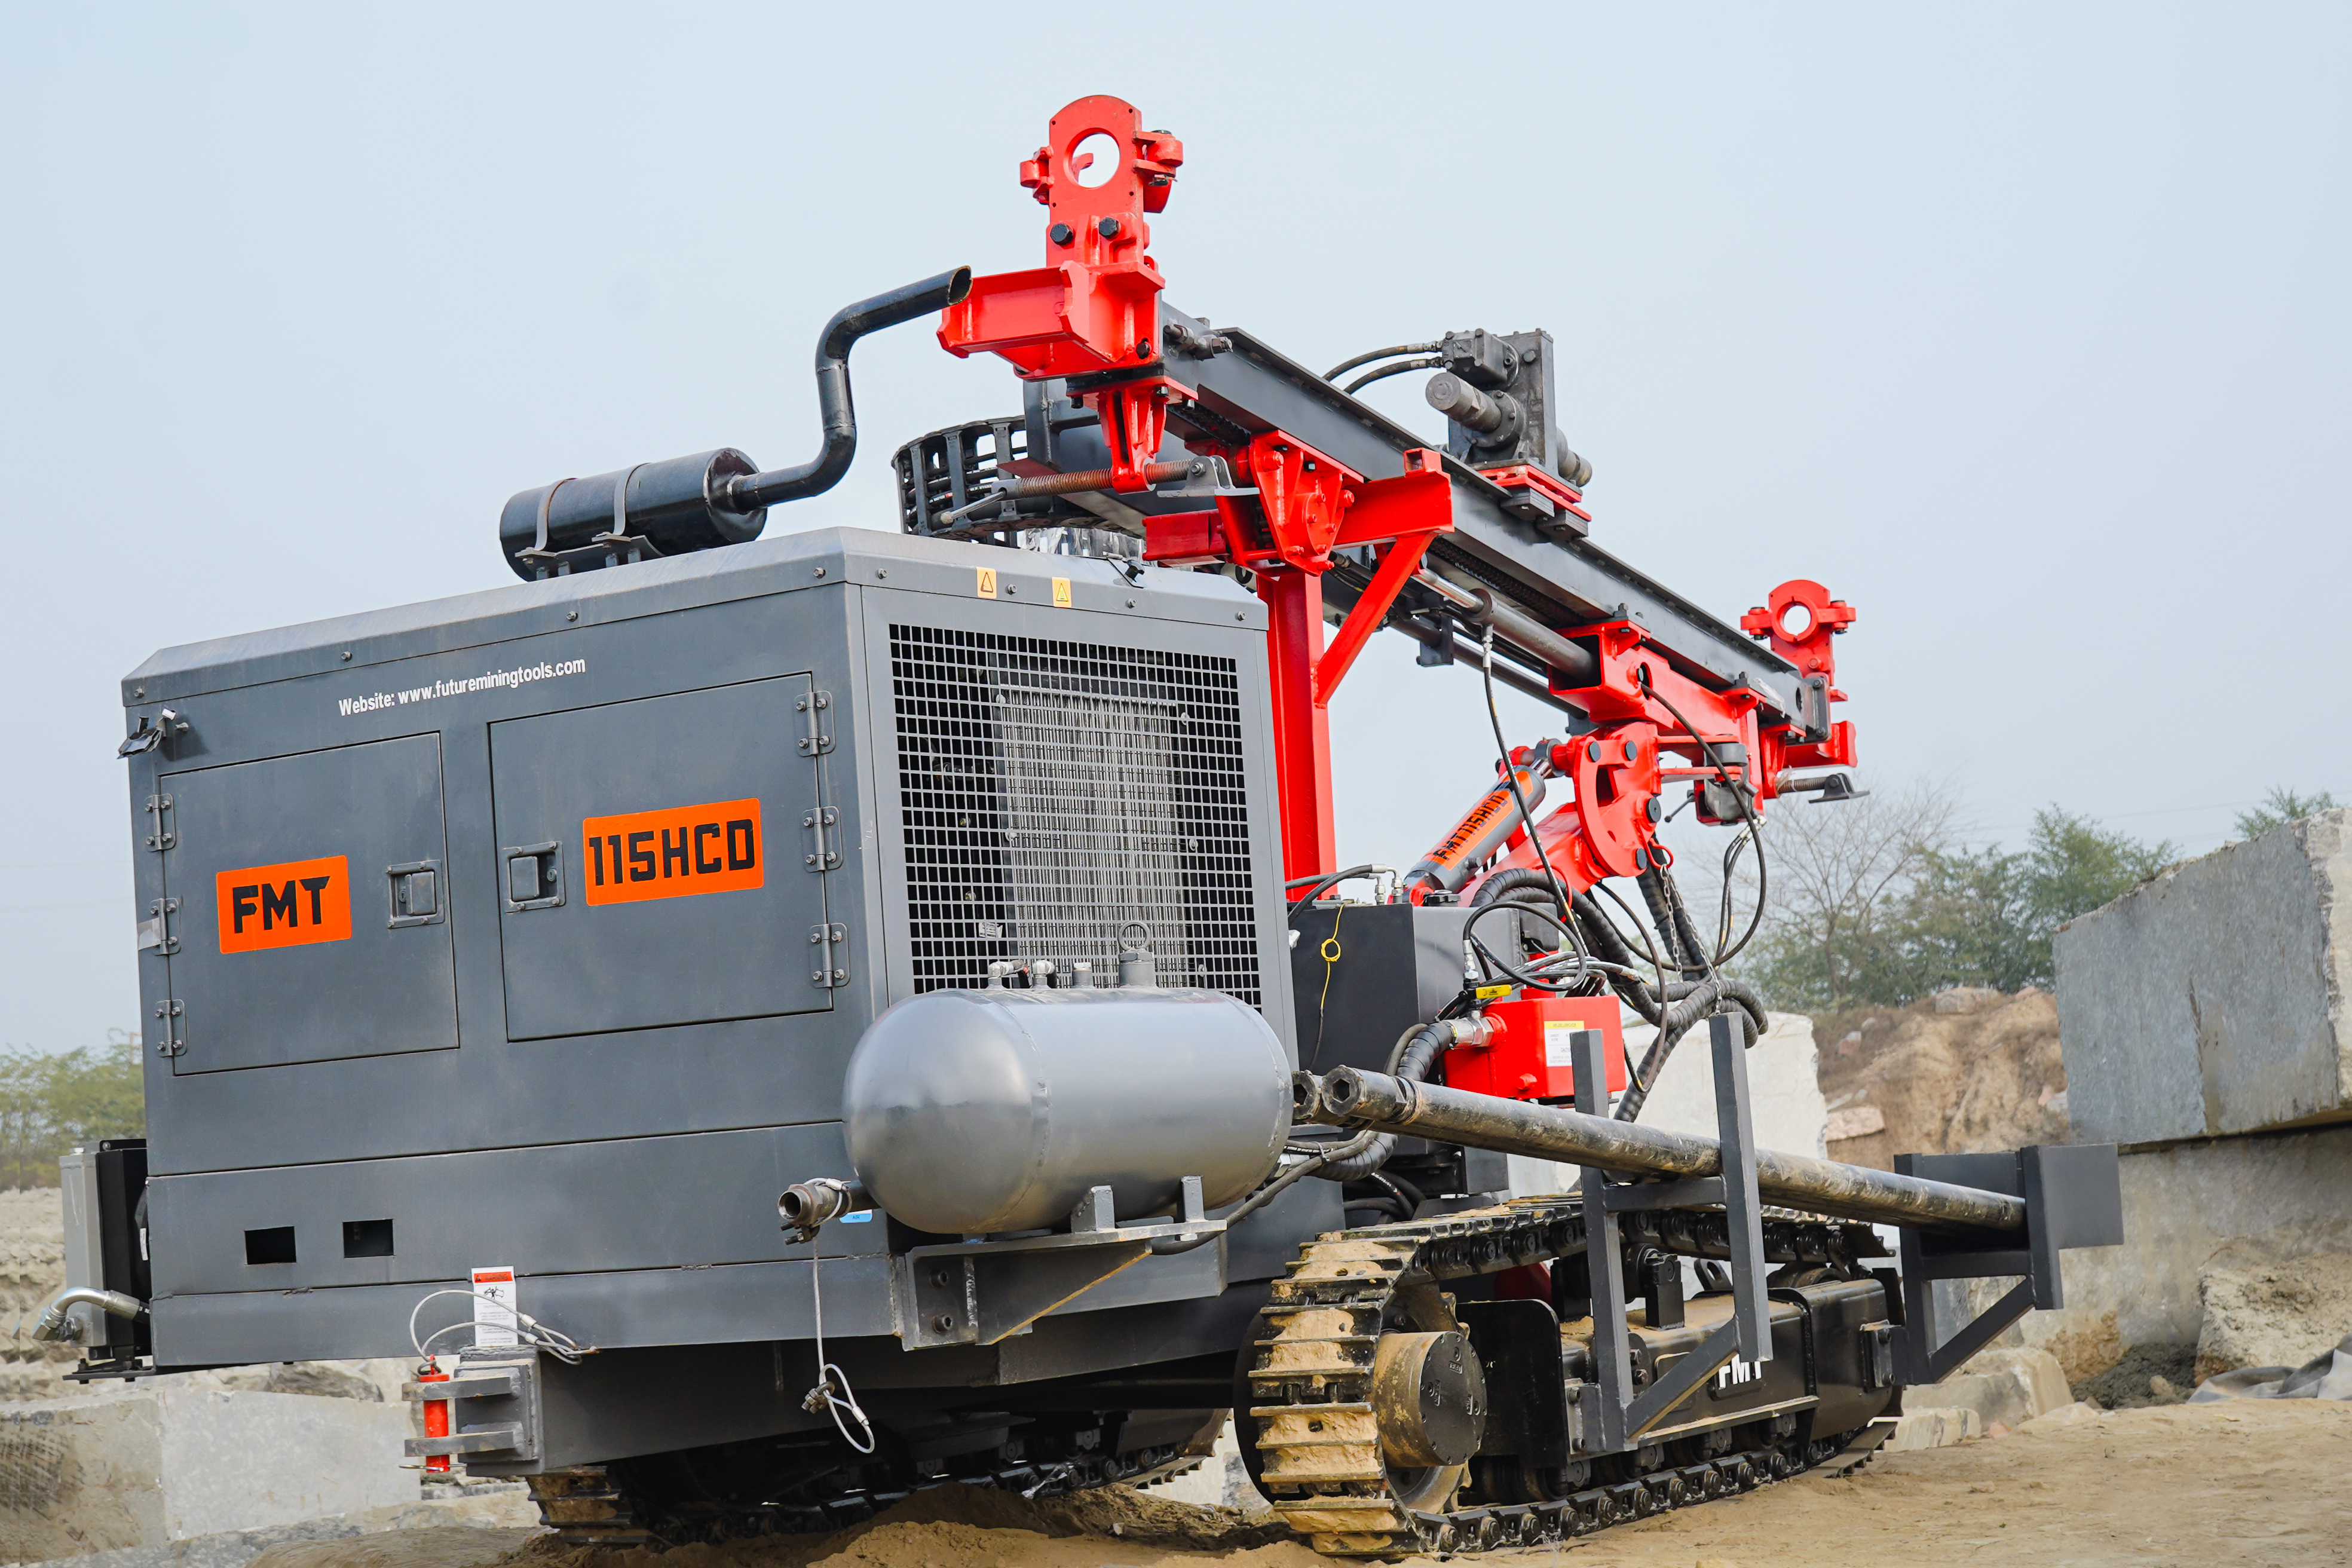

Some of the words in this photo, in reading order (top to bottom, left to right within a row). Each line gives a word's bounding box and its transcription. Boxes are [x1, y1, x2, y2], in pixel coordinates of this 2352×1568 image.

[338, 692, 395, 716] Website:
[397, 659, 586, 705] www.futureminingtools.com
[589, 819, 755, 886] 115HCD
[232, 875, 330, 934] FMT
